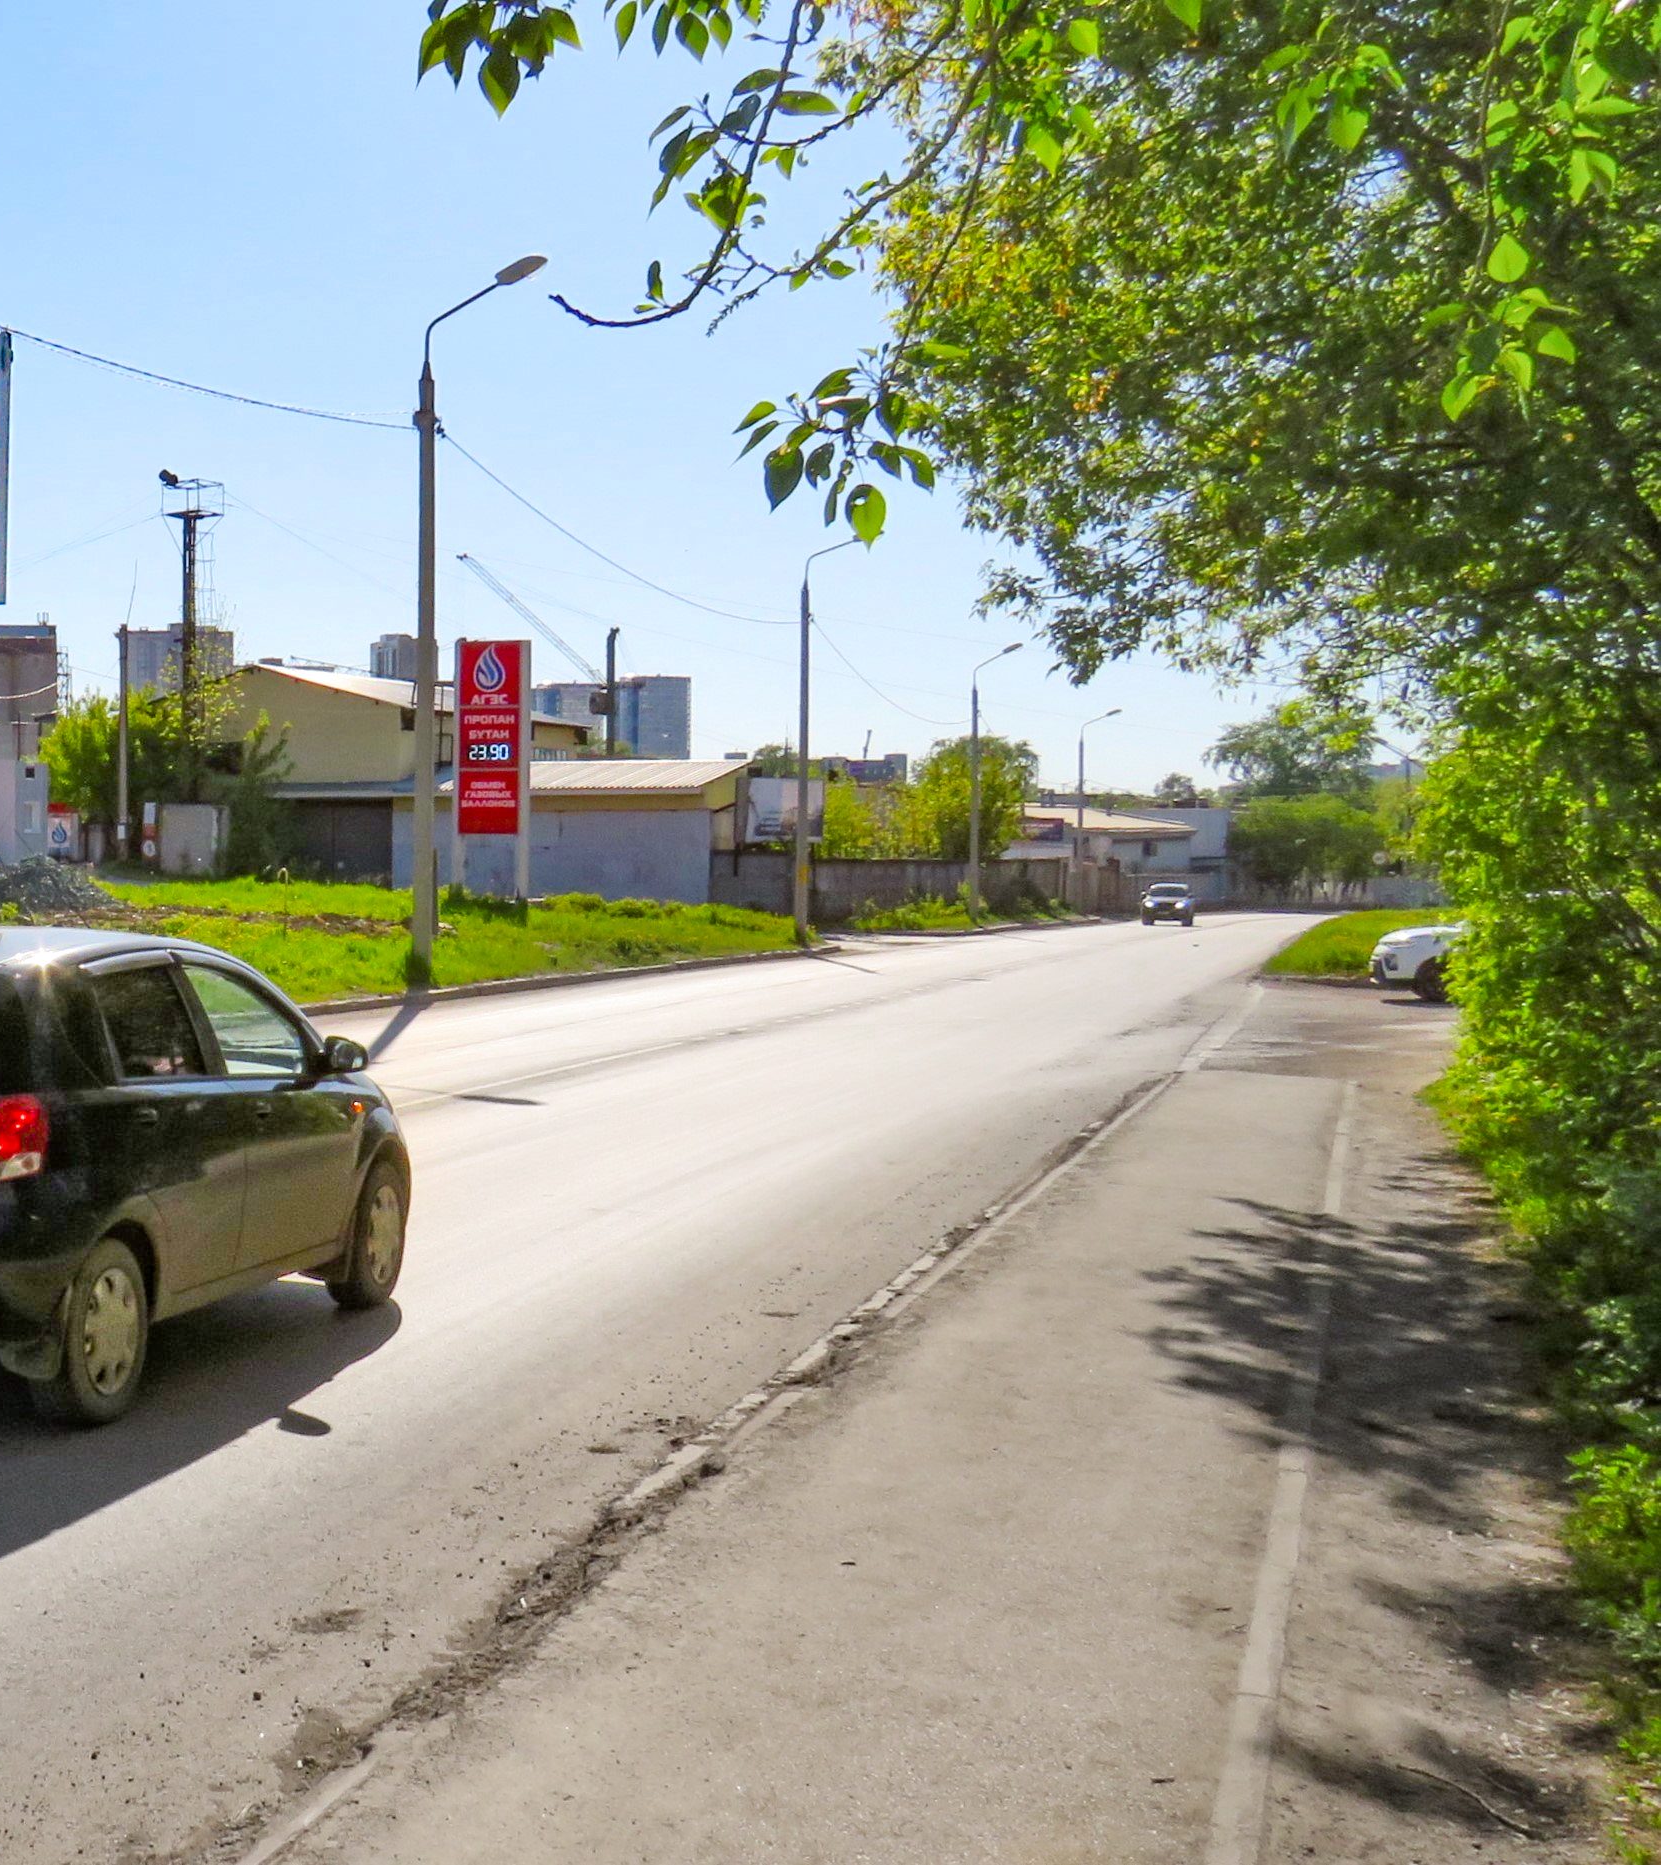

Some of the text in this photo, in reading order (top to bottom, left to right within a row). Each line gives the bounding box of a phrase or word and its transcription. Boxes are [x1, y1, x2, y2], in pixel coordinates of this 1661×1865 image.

[470, 693, 509, 705] АГЭС
[463, 714, 516, 725] ПРОПАН
[468, 729, 510, 740] БУТАН
[468, 744, 510, 761] 23.90
